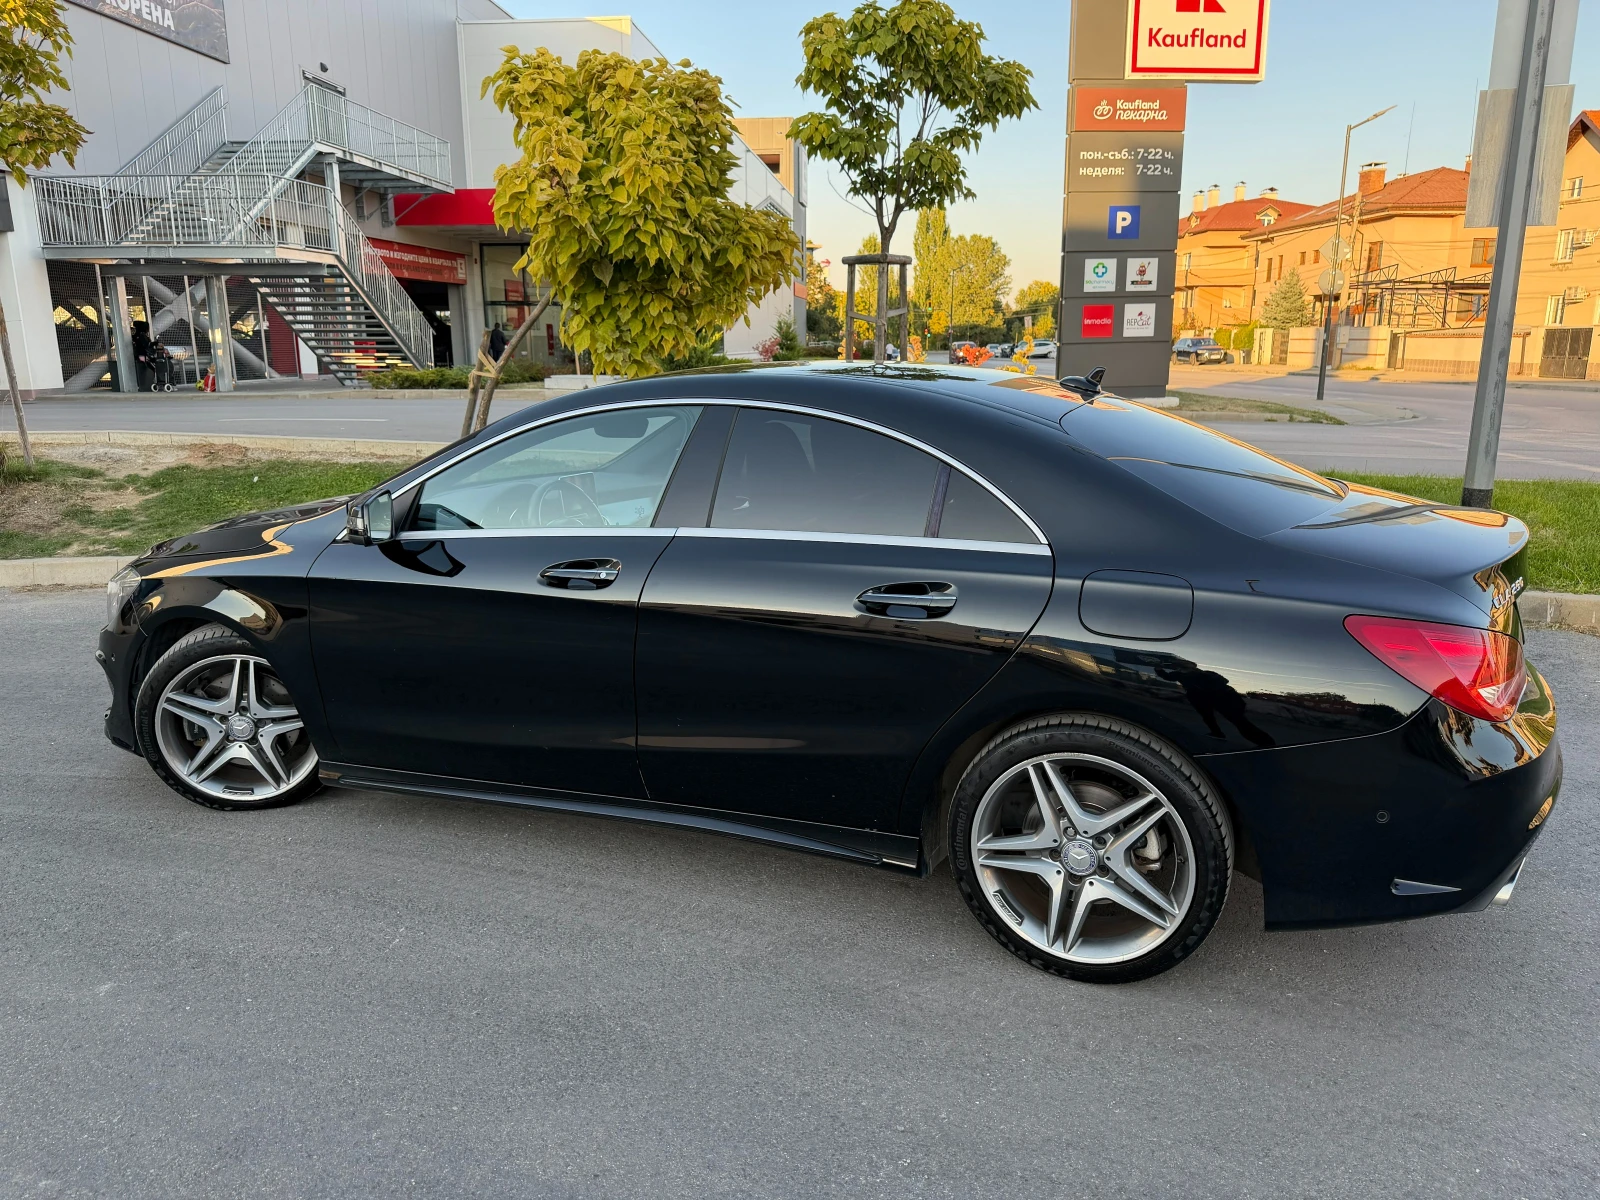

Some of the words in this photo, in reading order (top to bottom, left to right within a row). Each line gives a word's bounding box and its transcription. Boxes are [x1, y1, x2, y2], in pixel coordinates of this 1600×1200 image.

[1148, 27, 1247, 48] Kaufland
[1116, 99, 1160, 109] Kaufland
[1115, 109, 1168, 122] пекарна
[1079, 148, 1134, 160] пон.-съб.:
[1136, 148, 1163, 160] 7-22
[1164, 151, 1174, 160] ч.
[1079, 166, 1125, 177] неделя:
[1135, 164, 1161, 175] 7-22
[1163, 167, 1173, 175] ч.
[1115, 211, 1132, 234] P
[954, 808, 968, 870] Continental
